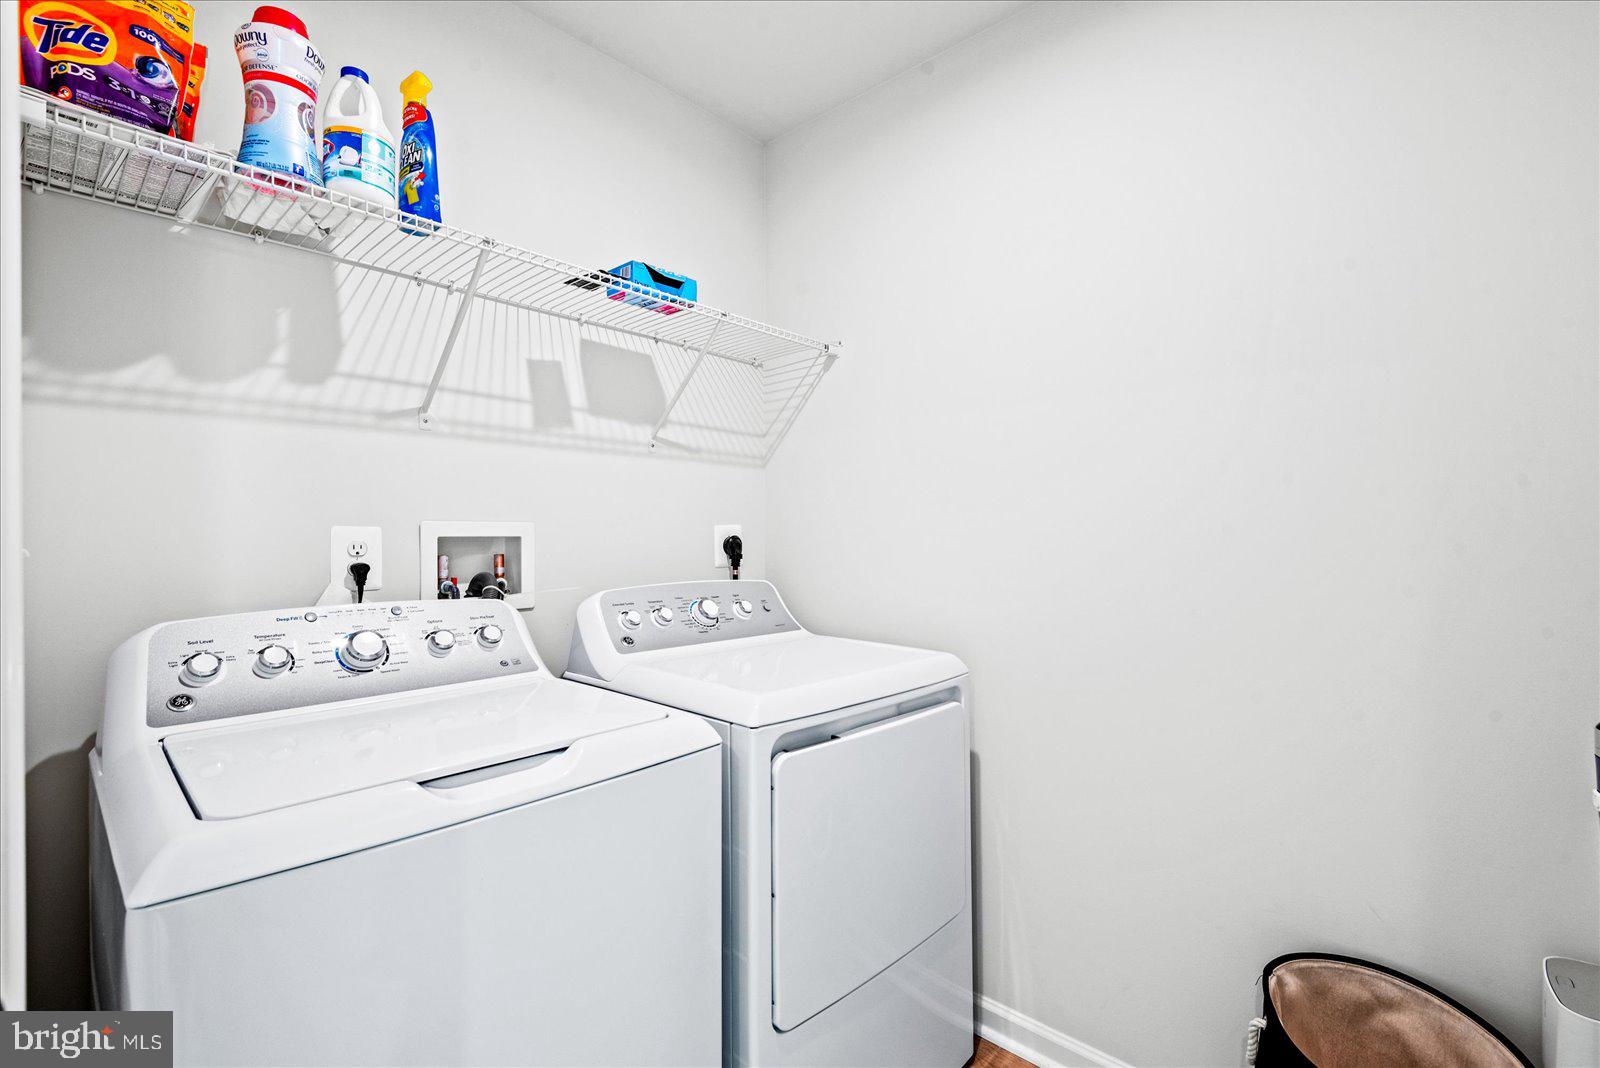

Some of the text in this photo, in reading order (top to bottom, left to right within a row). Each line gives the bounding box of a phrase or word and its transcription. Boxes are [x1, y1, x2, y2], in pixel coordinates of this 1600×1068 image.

[32, 16, 110, 54] Tide
[306, 45, 325, 72] Dow
[50, 62, 97, 81] PODS
[401, 149, 422, 169] LEAN
